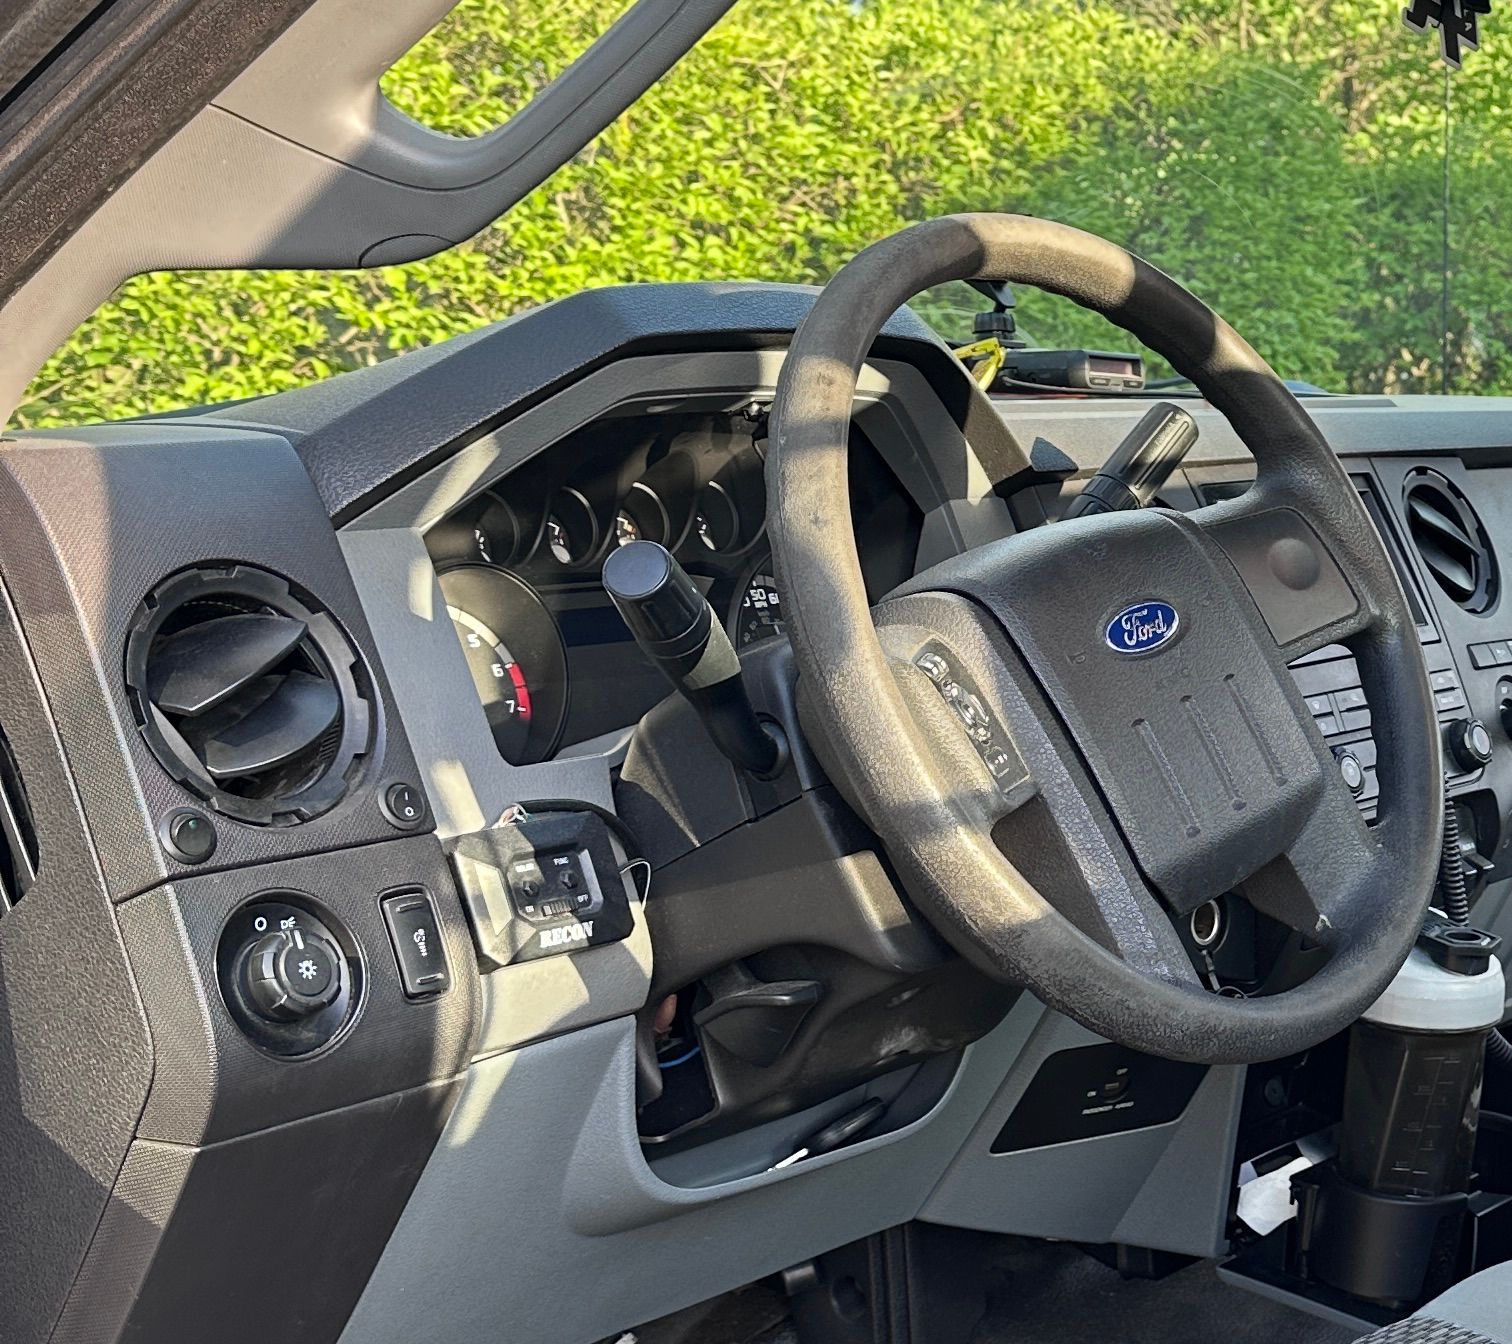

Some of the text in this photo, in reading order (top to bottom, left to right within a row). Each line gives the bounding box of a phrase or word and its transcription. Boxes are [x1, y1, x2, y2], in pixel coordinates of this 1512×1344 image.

[749, 588, 767, 601] 50
[1121, 608, 1168, 646] Ford
[491, 663, 504, 677] 6
[505, 700, 515, 713] 7
[538, 920, 594, 949] RECON
